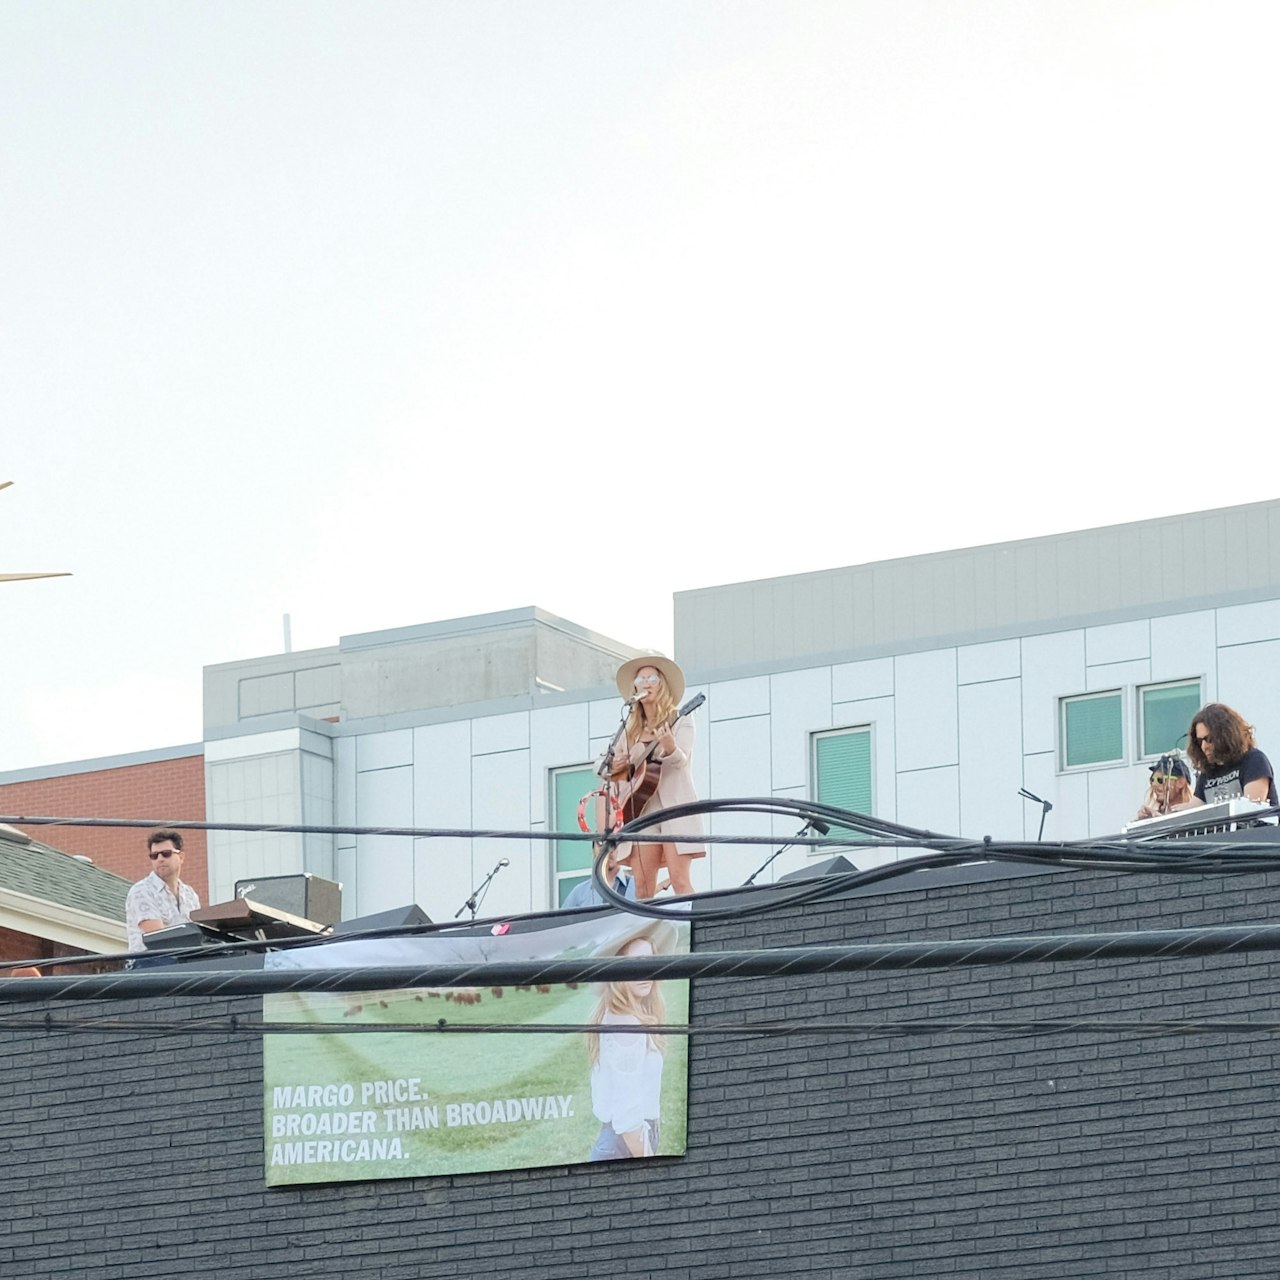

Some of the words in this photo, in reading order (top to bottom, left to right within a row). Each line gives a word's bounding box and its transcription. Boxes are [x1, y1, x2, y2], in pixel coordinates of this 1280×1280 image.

[273, 1083, 354, 1109] MARGO
[361, 1078, 428, 1105] PRICE.
[272, 1111, 377, 1138] BROADER
[383, 1105, 439, 1132] THAN
[446, 1094, 575, 1127] BROADWAY.
[270, 1137, 410, 1167] AMERICANA.
